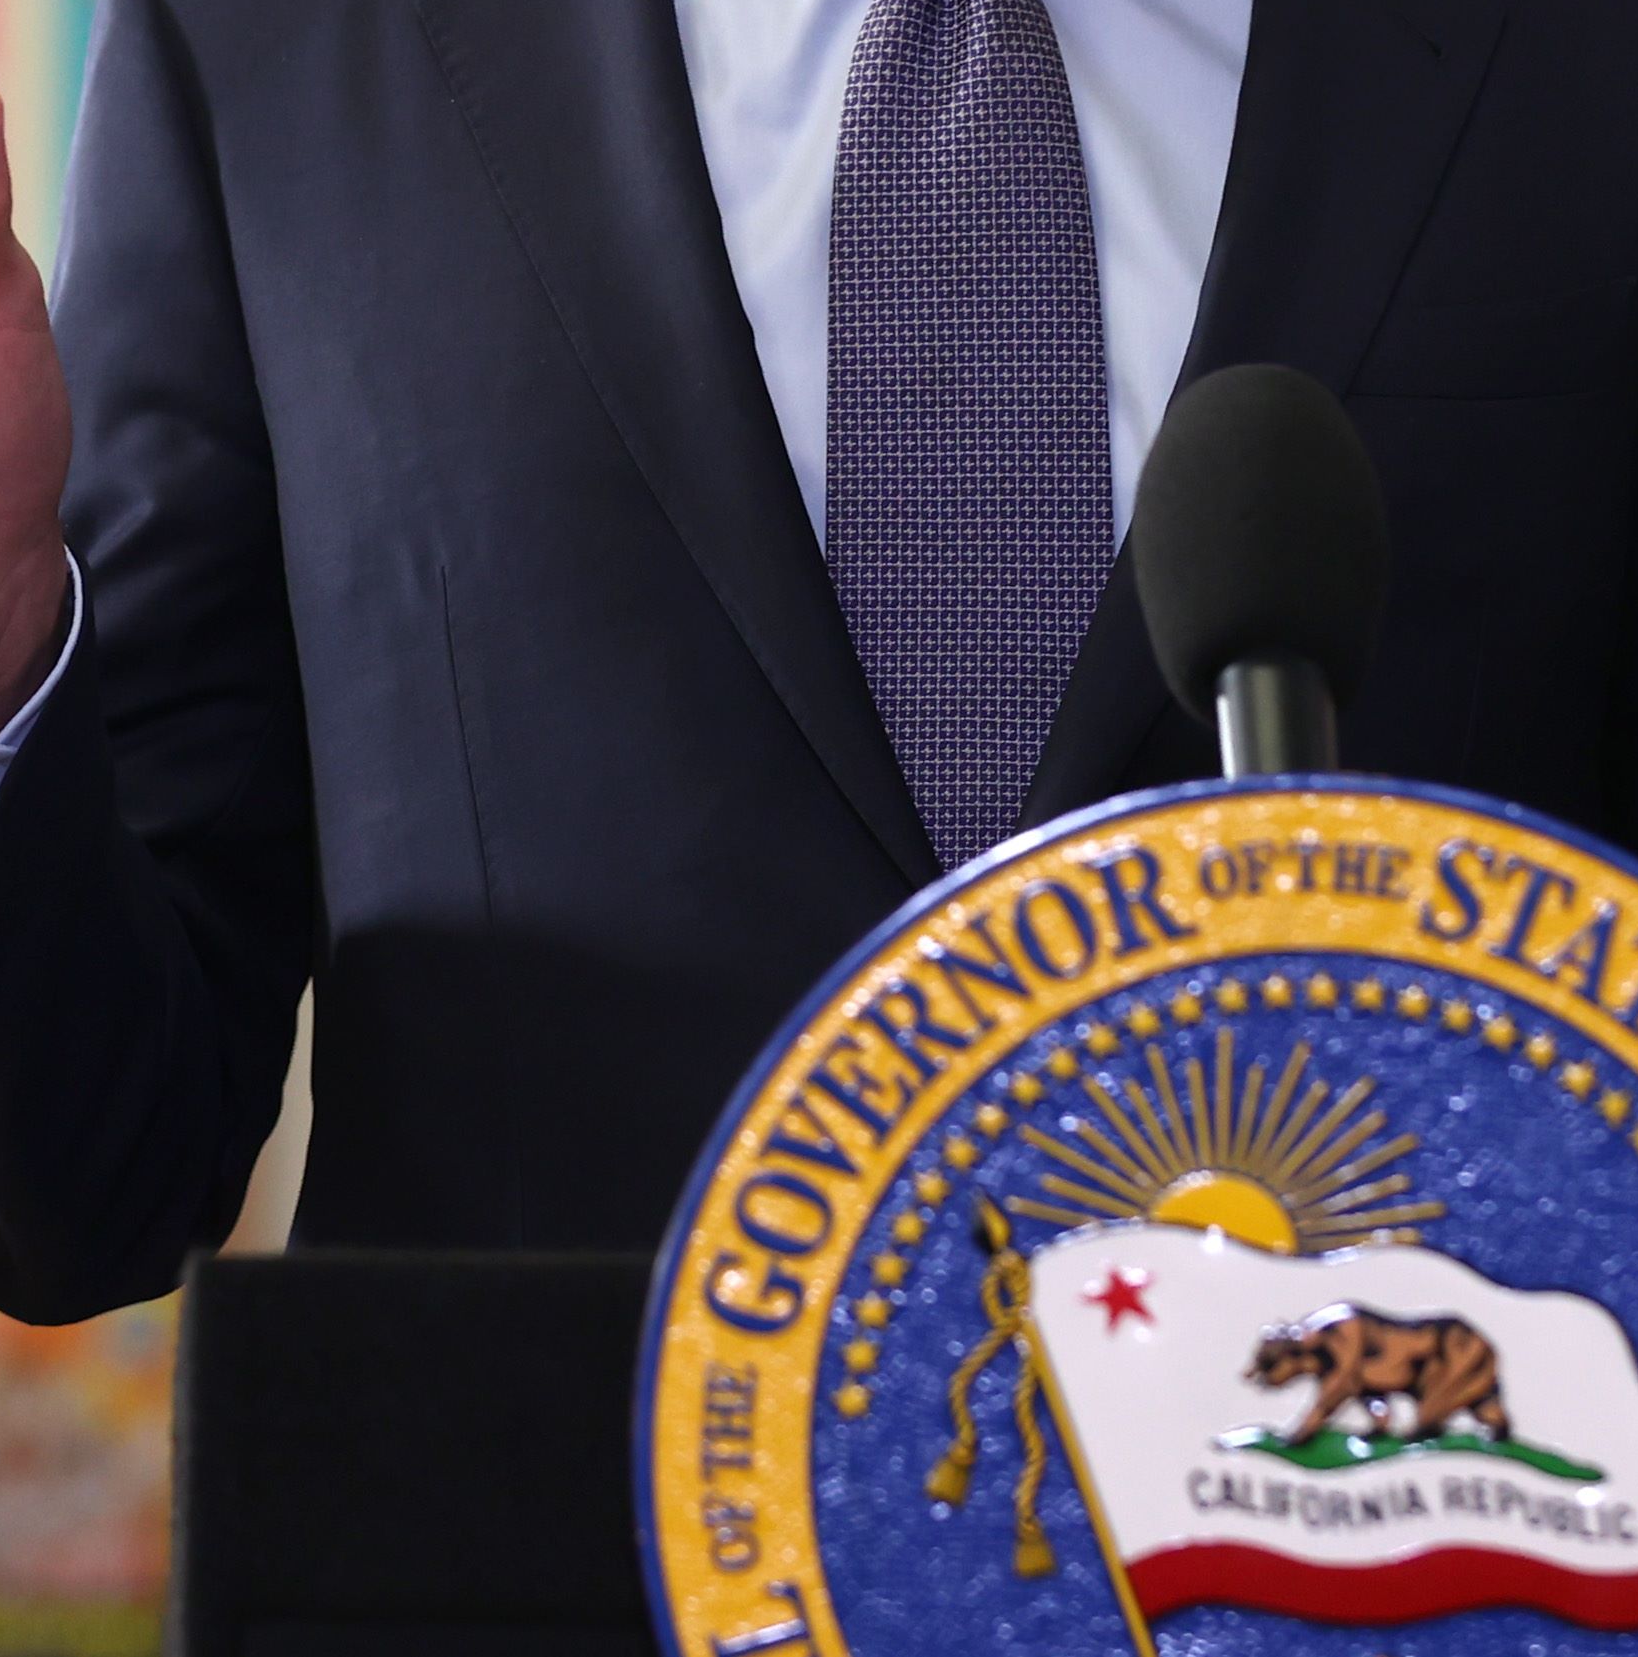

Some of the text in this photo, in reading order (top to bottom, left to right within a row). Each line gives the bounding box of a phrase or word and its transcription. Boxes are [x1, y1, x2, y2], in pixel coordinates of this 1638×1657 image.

[1199, 843, 1274, 900] OF
[1286, 841, 1412, 901] THE
[703, 845, 1199, 1335] GOVERNOR
[701, 1361, 759, 1483] THE
[1185, 1468, 1431, 1528] CALIFORNIA
